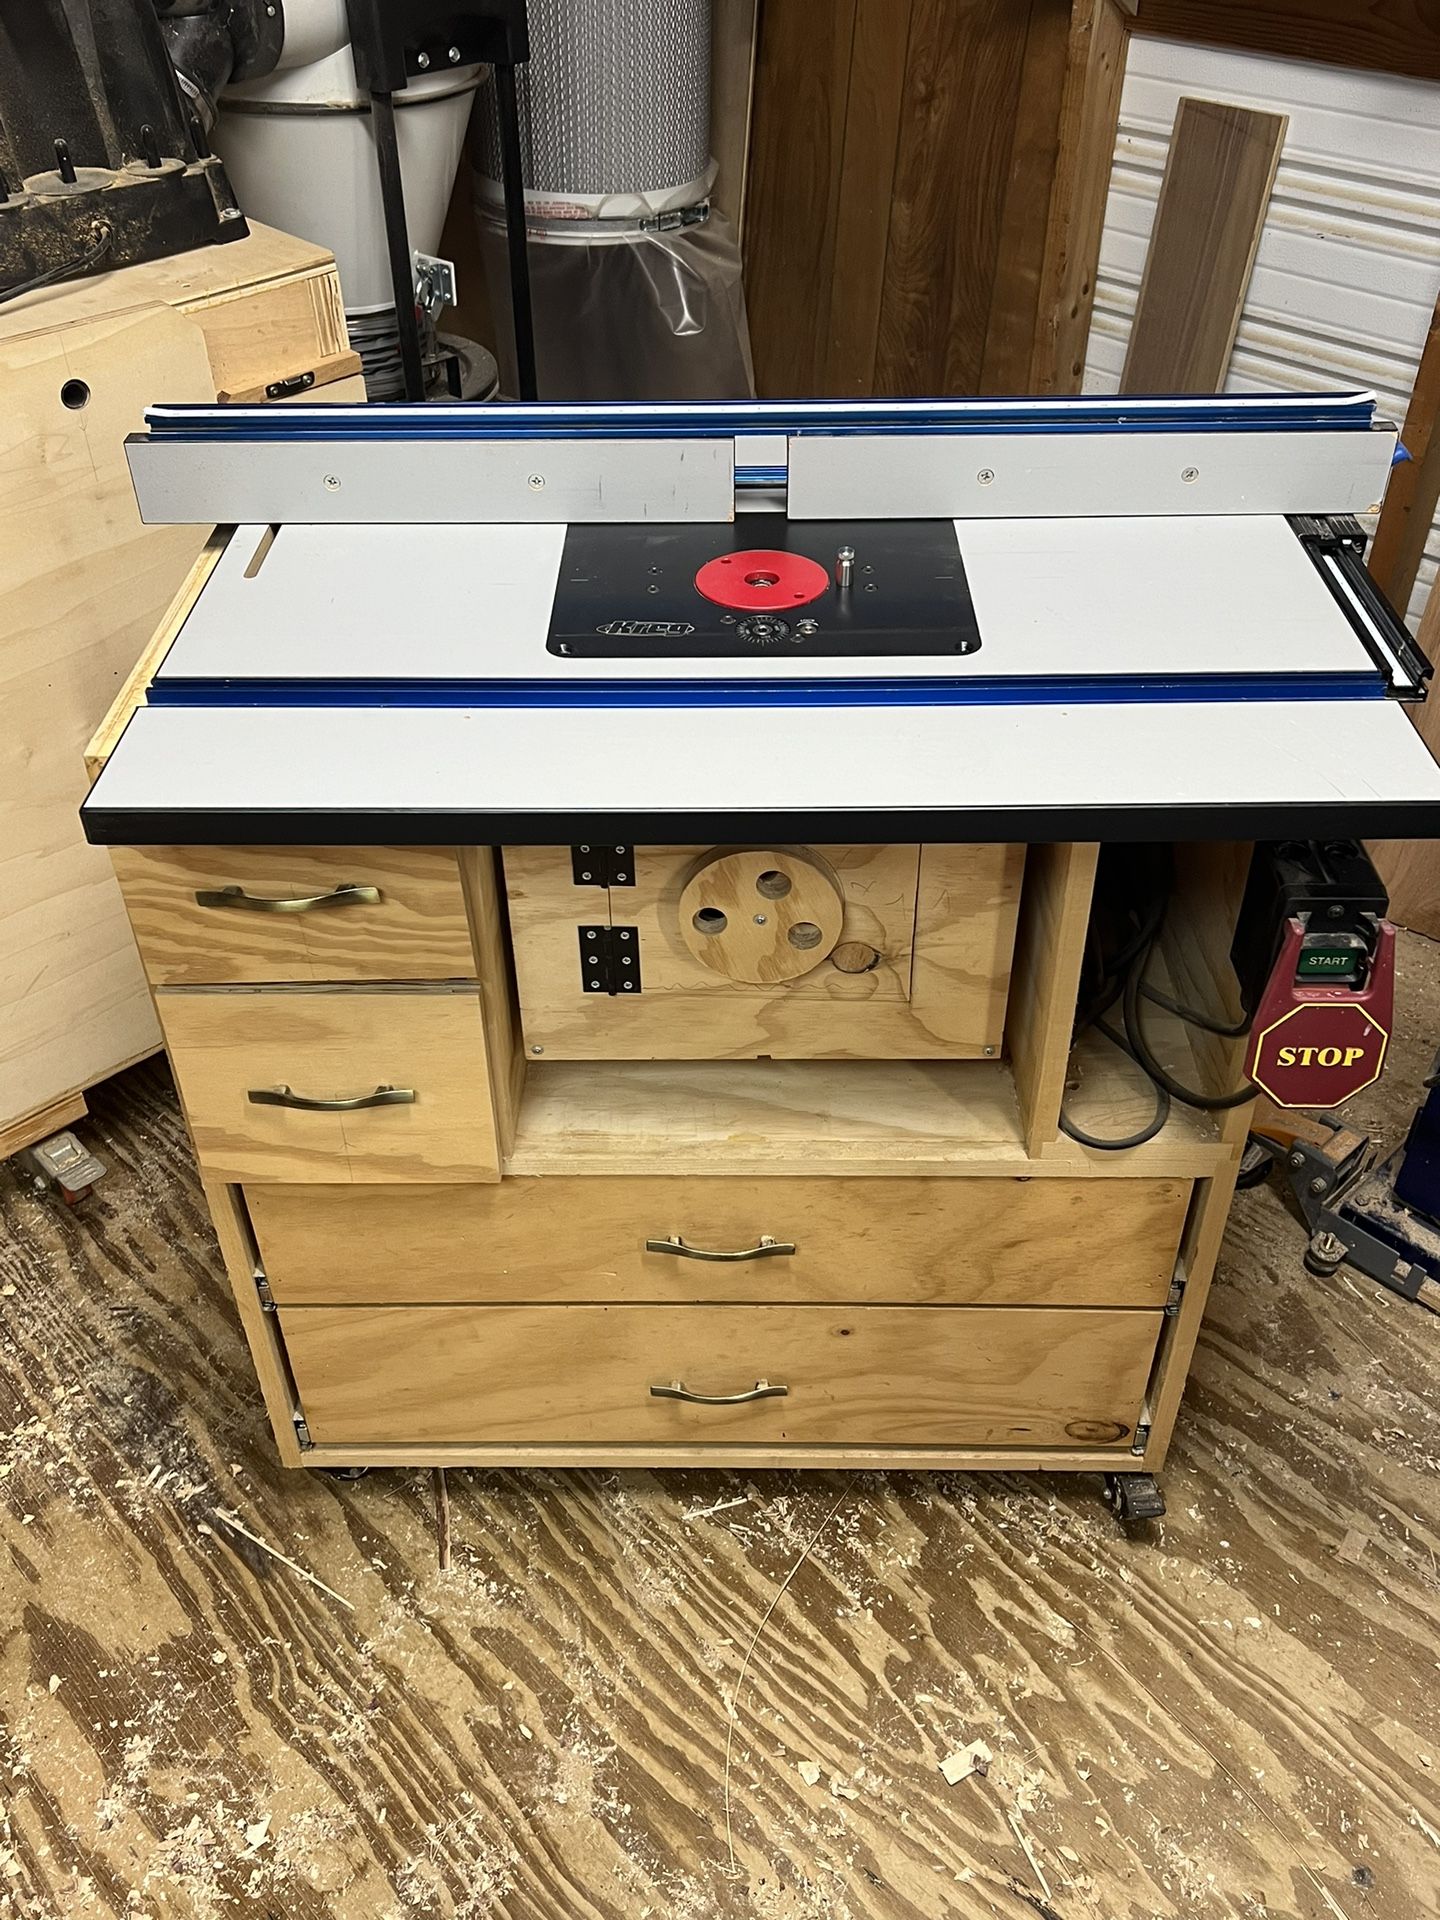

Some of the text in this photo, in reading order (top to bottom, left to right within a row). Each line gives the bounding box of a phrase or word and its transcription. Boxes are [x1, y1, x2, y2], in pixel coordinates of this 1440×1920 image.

[606, 620, 690, 637] Kreg
[1308, 956, 1349, 966] START
[1277, 1047, 1364, 1067] STOP
